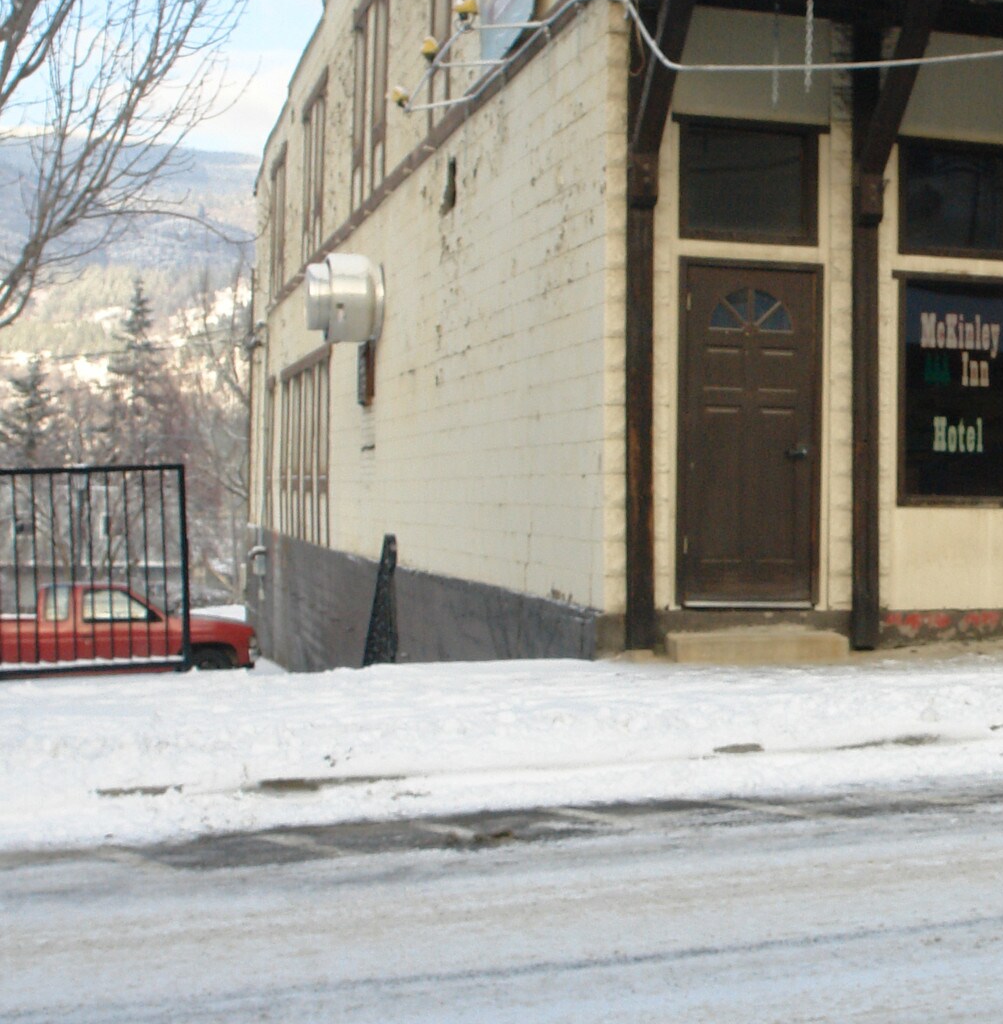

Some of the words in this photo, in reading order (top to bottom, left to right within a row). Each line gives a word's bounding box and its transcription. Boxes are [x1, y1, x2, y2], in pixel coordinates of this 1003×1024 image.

[920, 311, 1000, 359] McKinley
[961, 351, 990, 387] Inn
[933, 416, 984, 453] Hotel
